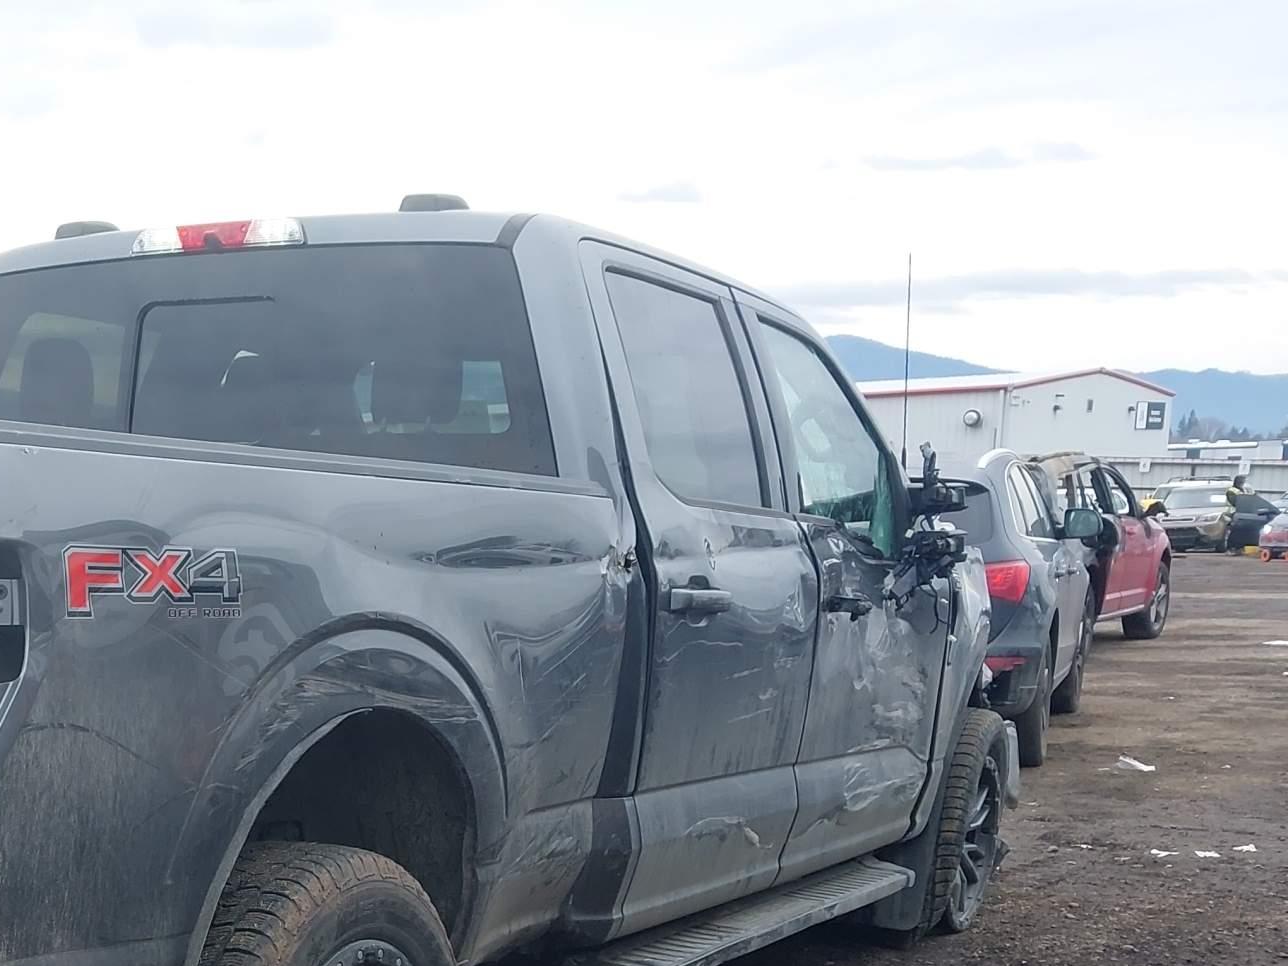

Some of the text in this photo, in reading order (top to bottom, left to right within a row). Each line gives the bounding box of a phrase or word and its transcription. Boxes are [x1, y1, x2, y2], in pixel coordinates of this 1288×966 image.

[62, 544, 243, 619] FX4
[168, 608, 241, 618] OFF ROAD
